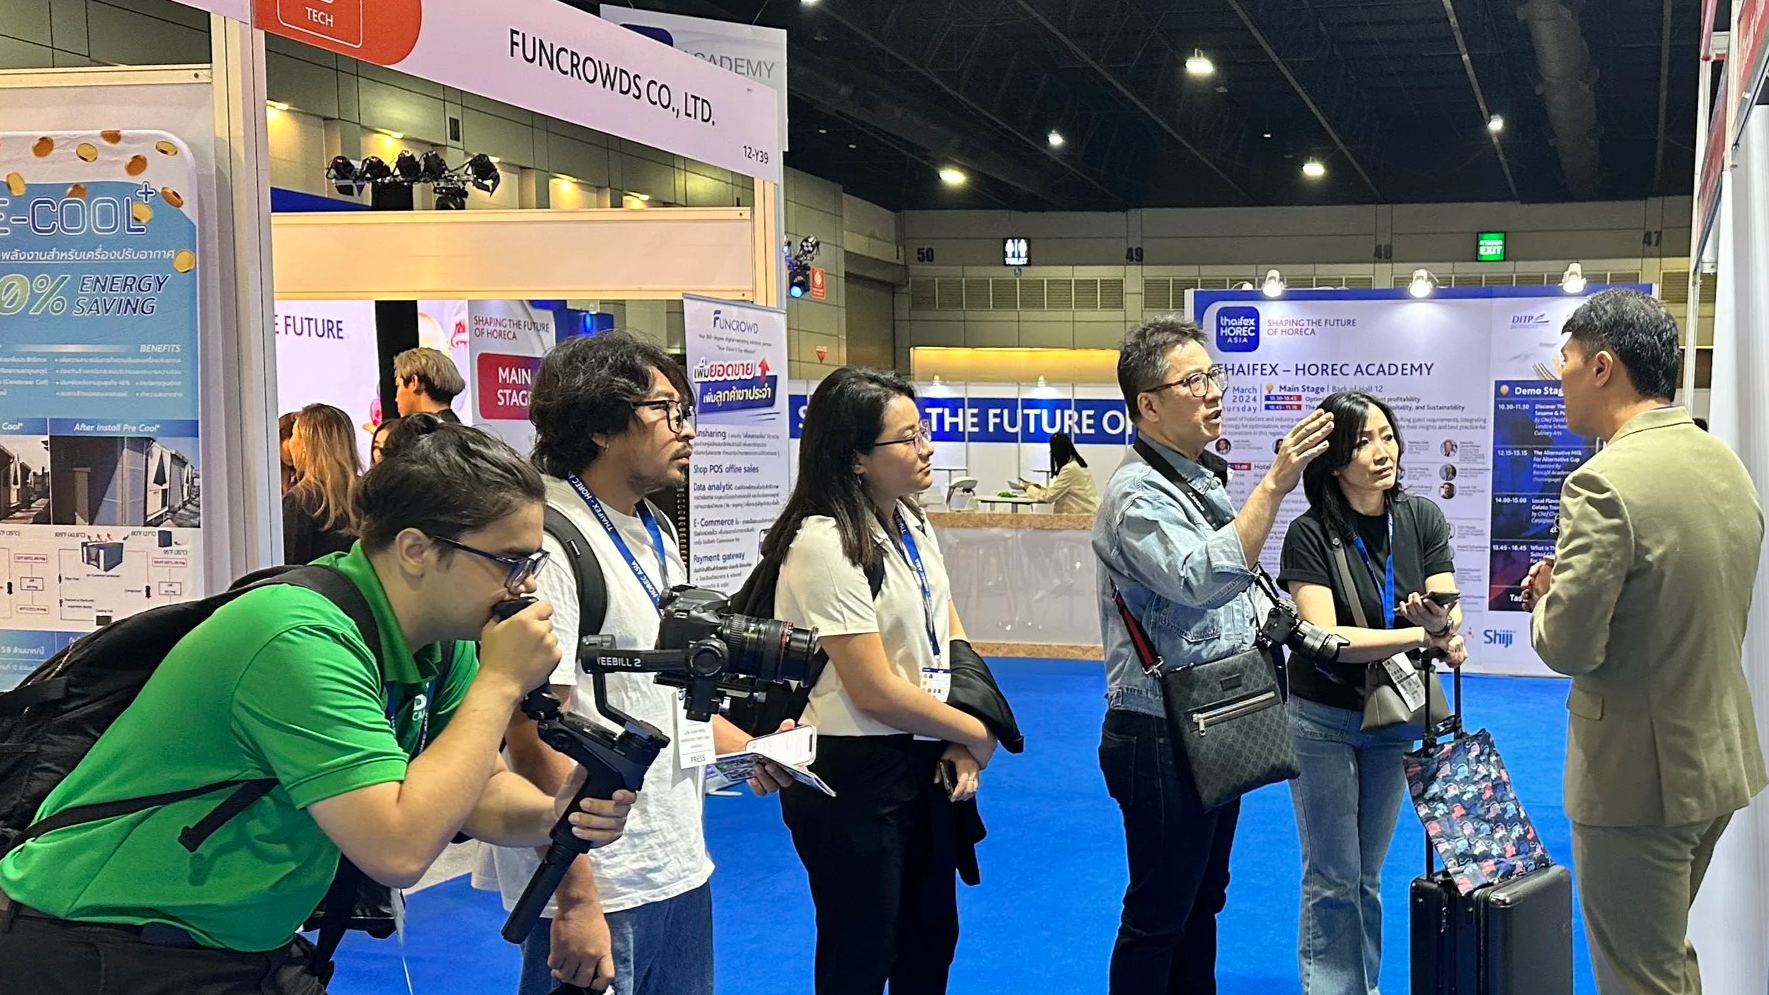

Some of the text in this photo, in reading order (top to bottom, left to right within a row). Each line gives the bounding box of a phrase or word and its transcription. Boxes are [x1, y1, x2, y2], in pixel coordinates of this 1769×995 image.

[305, 7, 334, 27] TECH
[684, 50, 775, 79] ADEMY
[510, 28, 715, 126] FUNCROWDS CO., LTD.
[743, 145, 769, 164] 12-Y39
[1642, 230, 1662, 247] 47
[917, 248, 934, 262] 50
[1126, 247, 1143, 262] 49
[1480, 246, 1502, 255] EXIT
[78, 274, 171, 294] ENERGY
[72, 298, 156, 316] SAVING
[473, 315, 550, 333] SHAPING THE FUTURE
[713, 309, 759, 334] FUNCROWD
[1220, 315, 1256, 327] thaifex
[1267, 318, 1357, 327] SHAPING THE FUTURE
[1512, 315, 1534, 324] DITP
[284, 315, 344, 340] FUTURE
[474, 327, 517, 340] OF HORECA
[1220, 326, 1256, 337] HOREC
[1267, 328, 1316, 336] OF HORECA
[140, 344, 182, 353] BENEFITS
[498, 366, 531, 384] MAIN
[1295, 363, 1349, 376] HOREC
[1353, 363, 1434, 377] ACADEMY
[1301, 385, 1325, 393] Stage
[1515, 386, 1564, 397] Demo Stag
[1232, 395, 1257, 403] 2024
[74, 423, 95, 432] After
[96, 424, 121, 432] Install
[925, 407, 980, 433] THE
[988, 408, 1095, 435] FUTURE
[694, 464, 708, 475] Shop
[709, 464, 723, 473] POS
[743, 464, 759, 473] sales
[694, 483, 706, 491] Data
[708, 482, 733, 492] analytic
[591, 504, 613, 532] THAIFEX
[694, 552, 745, 565] Payment gateway
[1483, 629, 1513, 648] Shiji
[633, 658, 642, 667] 2
[691, 754, 706, 763] PRESS
